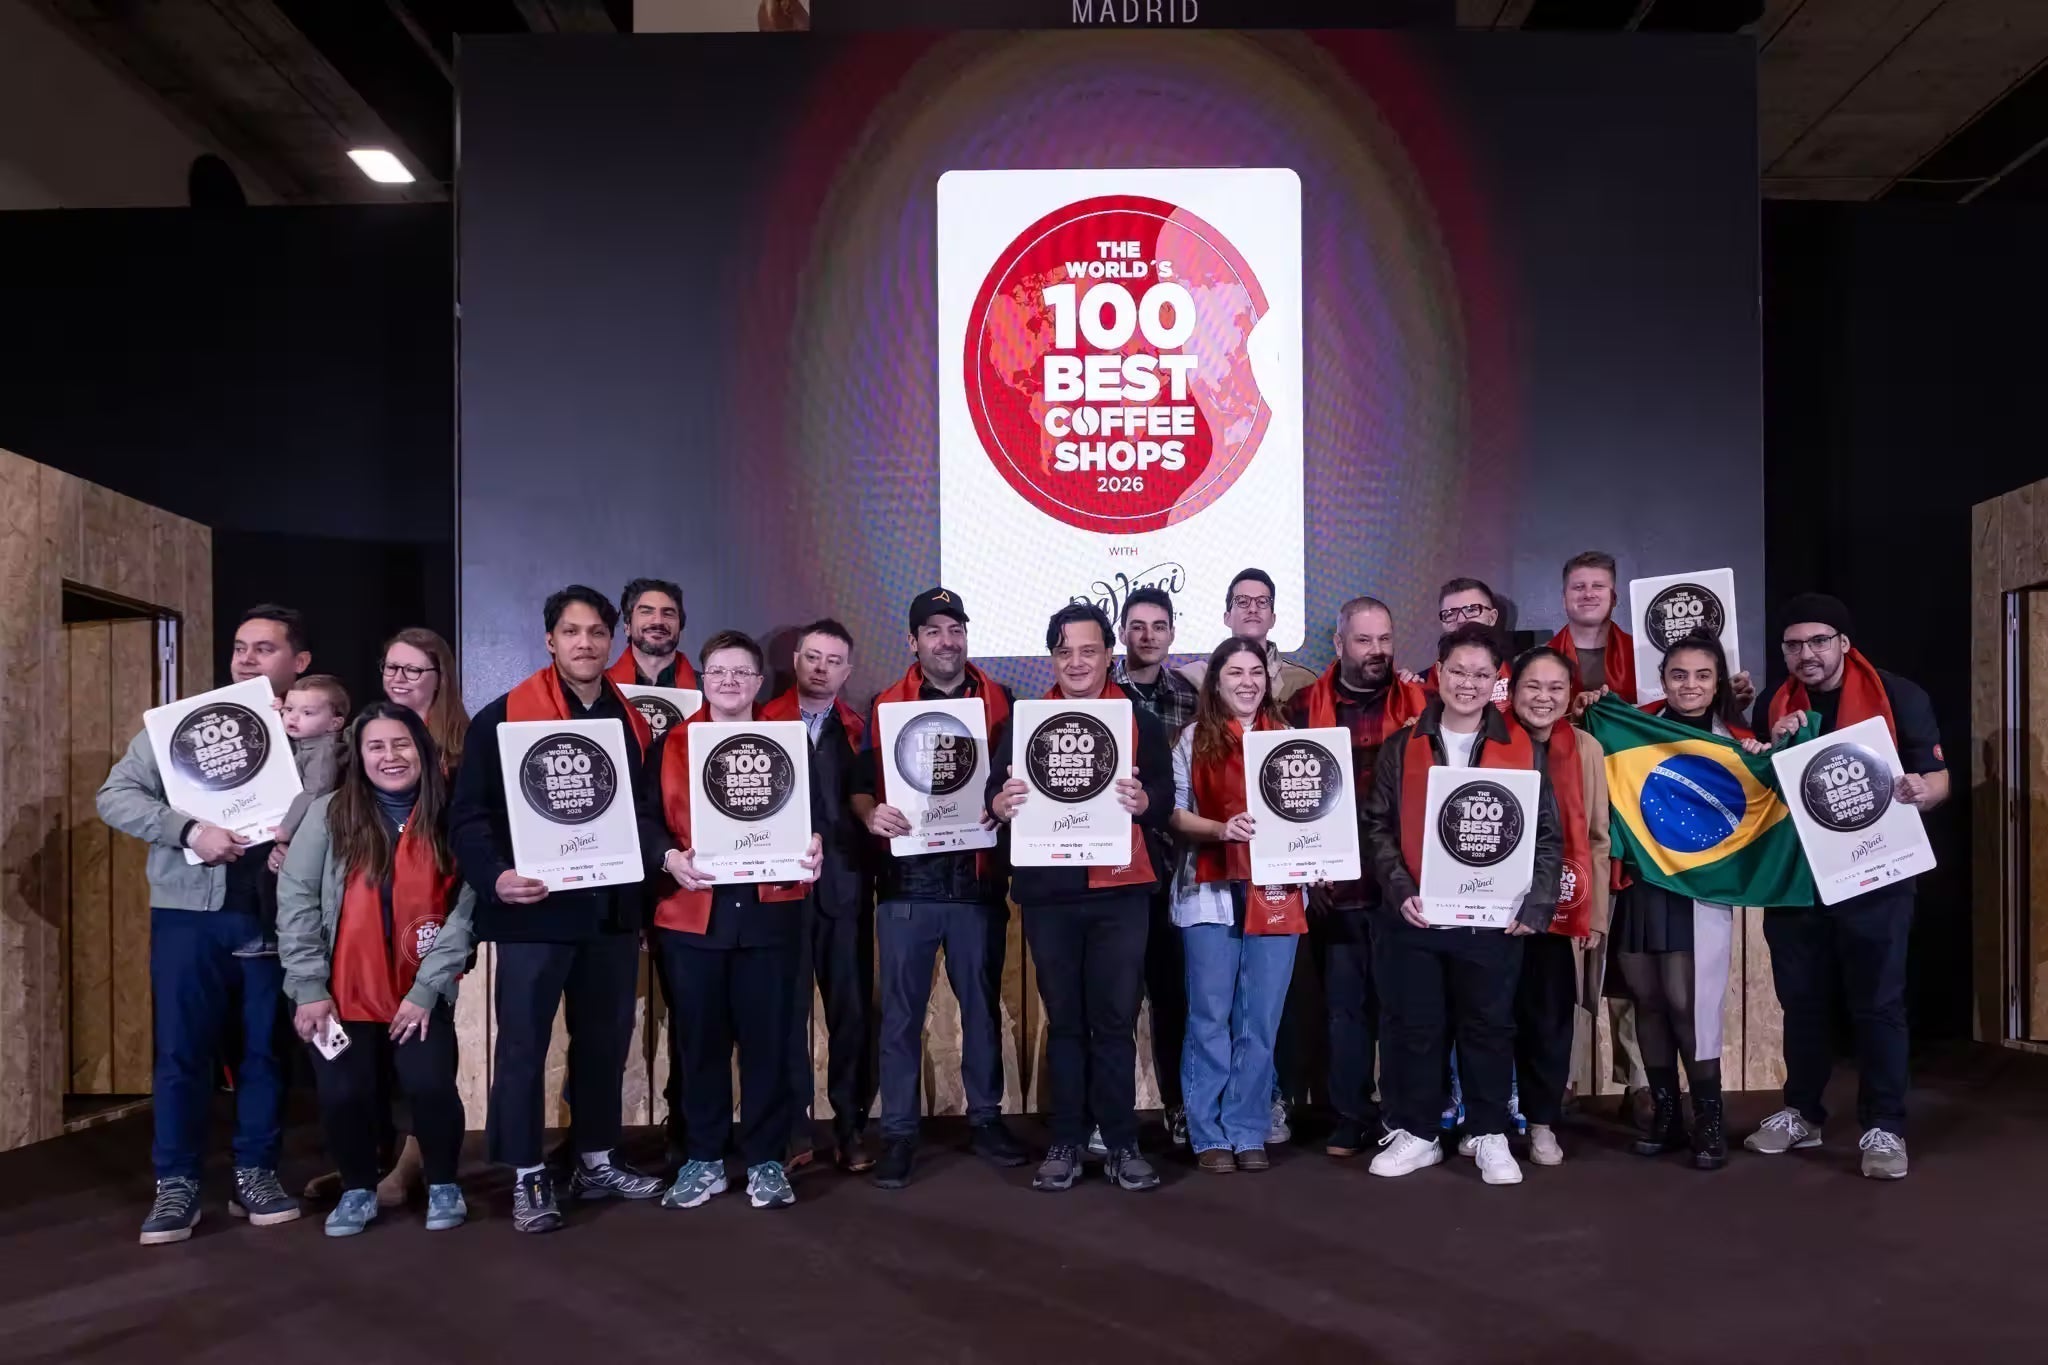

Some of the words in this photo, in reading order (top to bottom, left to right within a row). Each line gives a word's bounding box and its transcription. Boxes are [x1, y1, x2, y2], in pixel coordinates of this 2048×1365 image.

[1072, 0, 1198, 24] MADRID
[1097, 241, 1141, 258] THE
[1042, 283, 1197, 350] 100
[1044, 355, 1198, 402] BEST
[1044, 407, 1196, 436] COFFEE
[1054, 442, 1185, 472] SHOPS
[1096, 476, 1144, 493] 2026
[1108, 547, 1138, 556] WITH
[1663, 600, 1703, 618] 100
[1664, 615, 1704, 630] BEST
[1665, 629, 1692, 638] COFF
[190, 719, 238, 748] 100
[914, 732, 956, 749] 100
[196, 736, 242, 761] BEST
[1049, 734, 1094, 752] 100
[201, 749, 247, 770] COFFEE
[207, 759, 246, 778] SHOPS
[542, 754, 590, 775] 100
[725, 754, 770, 773] 100
[1048, 754, 1094, 766] BEST
[1279, 759, 1320, 777] 100
[726, 773, 771, 787] BEST
[928, 772, 954, 780] OPS
[1048, 768, 1093, 776] COFFEE
[1819, 761, 1864, 788] 100
[546, 774, 592, 790] BEST
[1051, 777, 1089, 786] SHOPS
[1280, 777, 1321, 790] BEST
[1826, 778, 1868, 803] BEST
[548, 788, 594, 799] COFFEE
[727, 787, 771, 796] COFFEE
[730, 796, 768, 805] SHOPS
[1281, 790, 1321, 799] COFFEE
[552, 797, 592, 809] SHOPS
[1284, 798, 1319, 807] SHOPS
[1831, 791, 1873, 811] COFFEE
[1461, 801, 1503, 820] 100
[1836, 801, 1873, 820] SHOPS
[1052, 812, 1089, 831] DaVinci
[1459, 820, 1502, 834] BEST
[560, 833, 595, 855] DaVinci
[734, 830, 769, 850] DaVinci
[1288, 832, 1320, 852] DaVinci
[1459, 833, 1500, 843] COFFEE
[1460, 842, 1496, 852] SHOPS
[1851, 833, 1883, 862] DaVinci
[1458, 876, 1493, 893] DaVinci
